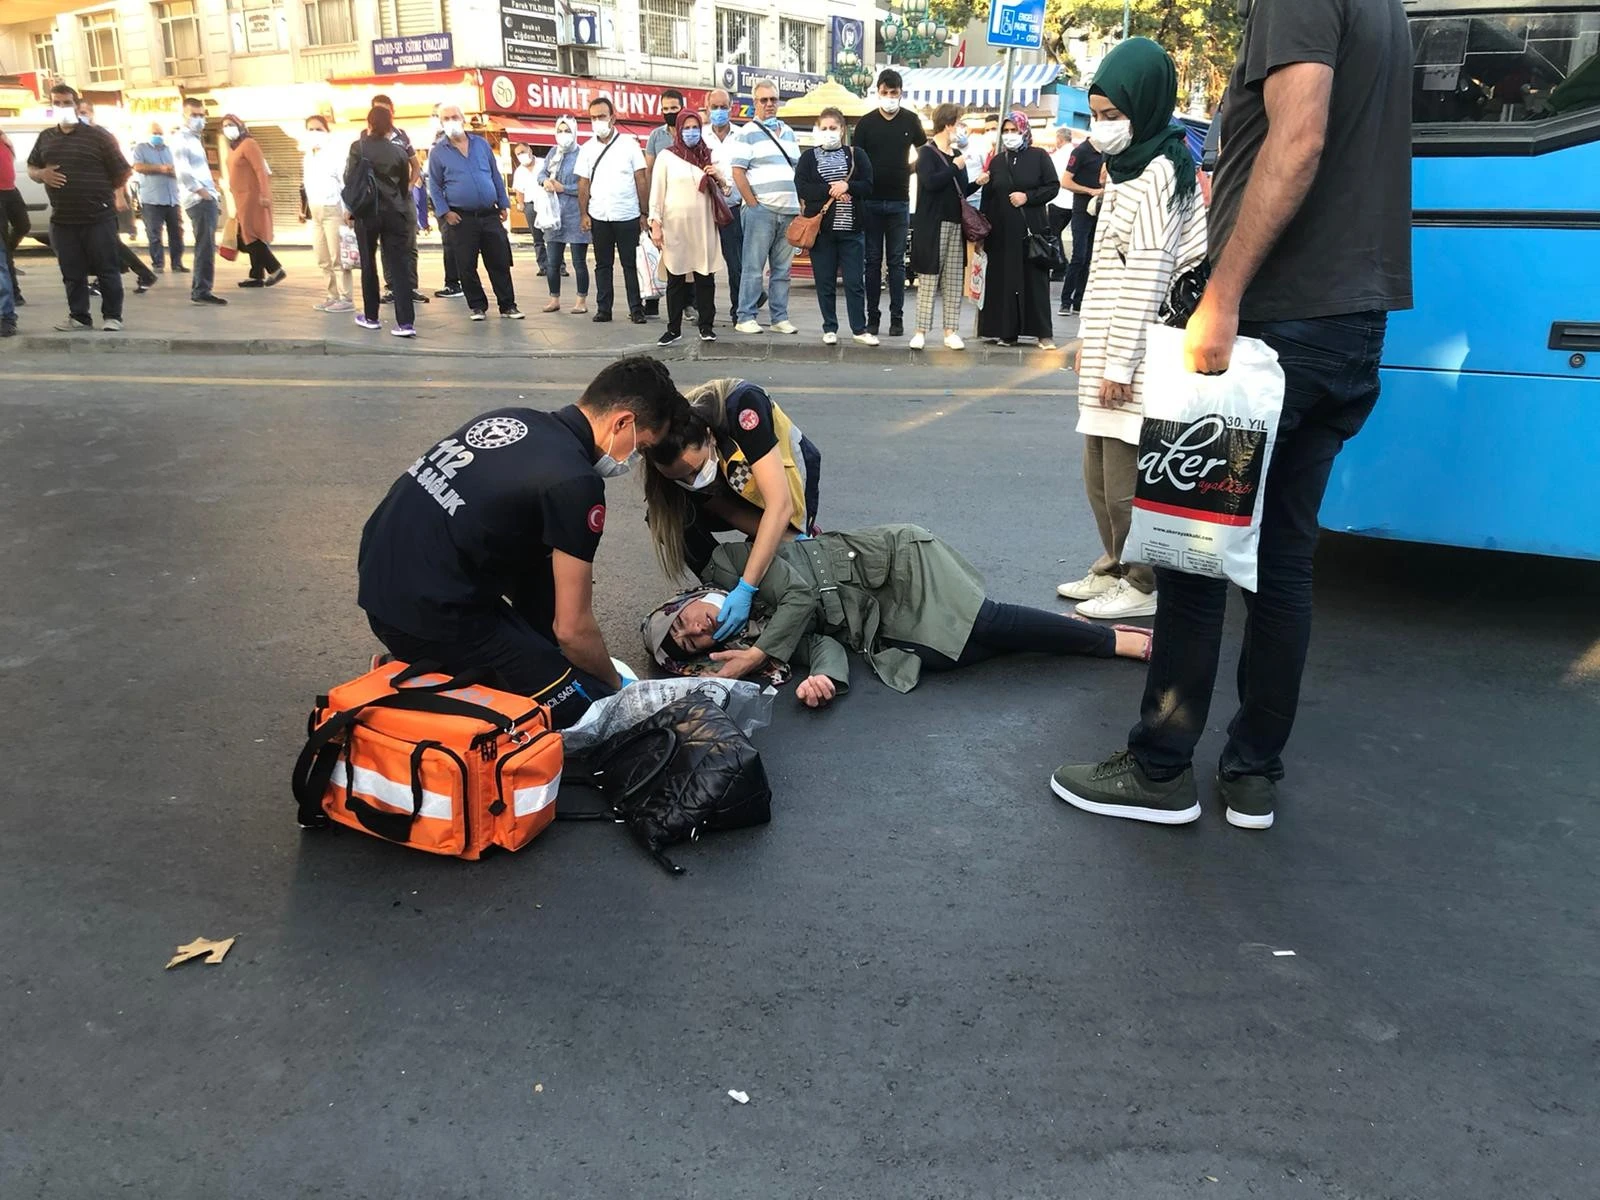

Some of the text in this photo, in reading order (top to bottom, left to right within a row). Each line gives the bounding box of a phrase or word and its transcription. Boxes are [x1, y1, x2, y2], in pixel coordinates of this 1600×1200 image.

[527, 77, 590, 111] SİMİT
[1227, 416, 1268, 430] 30. YIL
[428, 438, 474, 479] 112
[1137, 416, 1227, 491] aker
[417, 467, 466, 517] SAĞLIK
